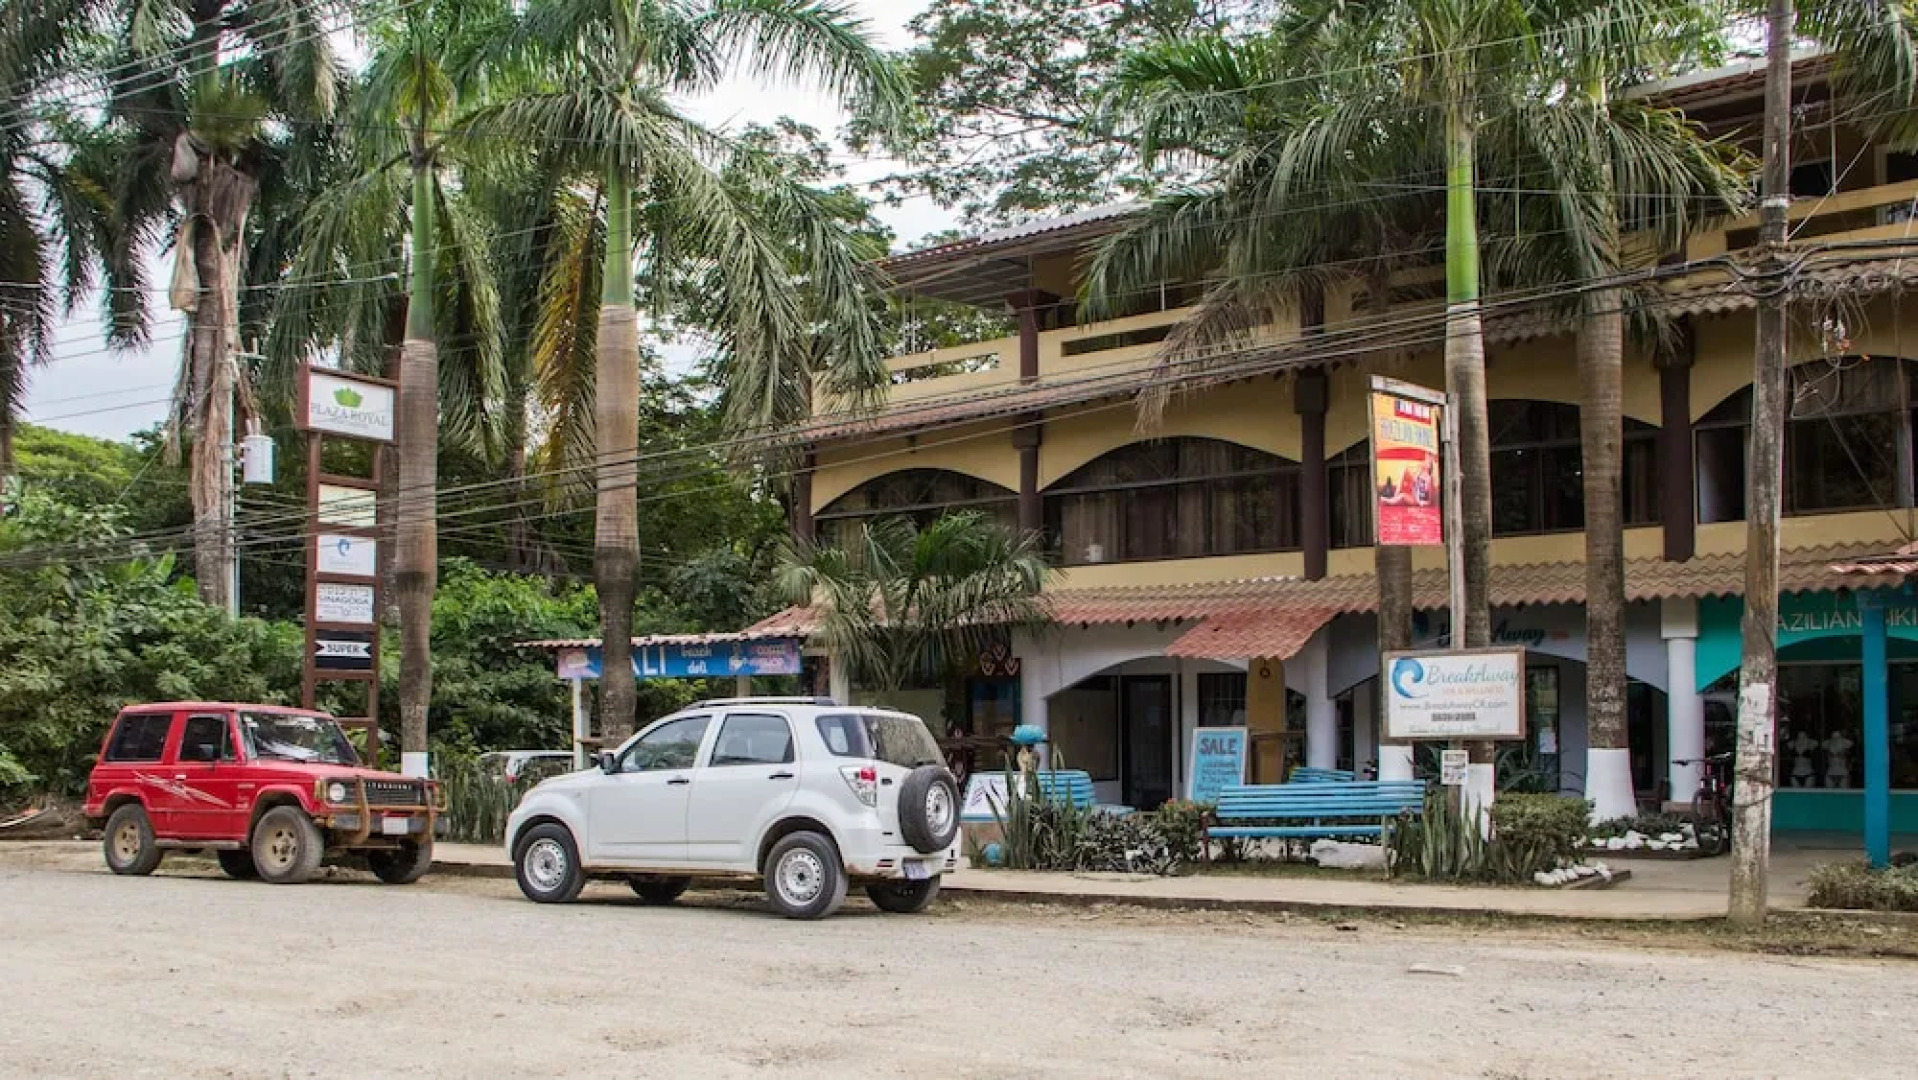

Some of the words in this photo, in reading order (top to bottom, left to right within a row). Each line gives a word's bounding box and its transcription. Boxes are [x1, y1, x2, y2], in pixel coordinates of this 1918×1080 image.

[310, 402, 349, 419] PLAZA
[350, 410, 389, 427] ROYAL
[1777, 610, 1863, 631] AZILIAN
[1200, 737, 1237, 755] SALE
